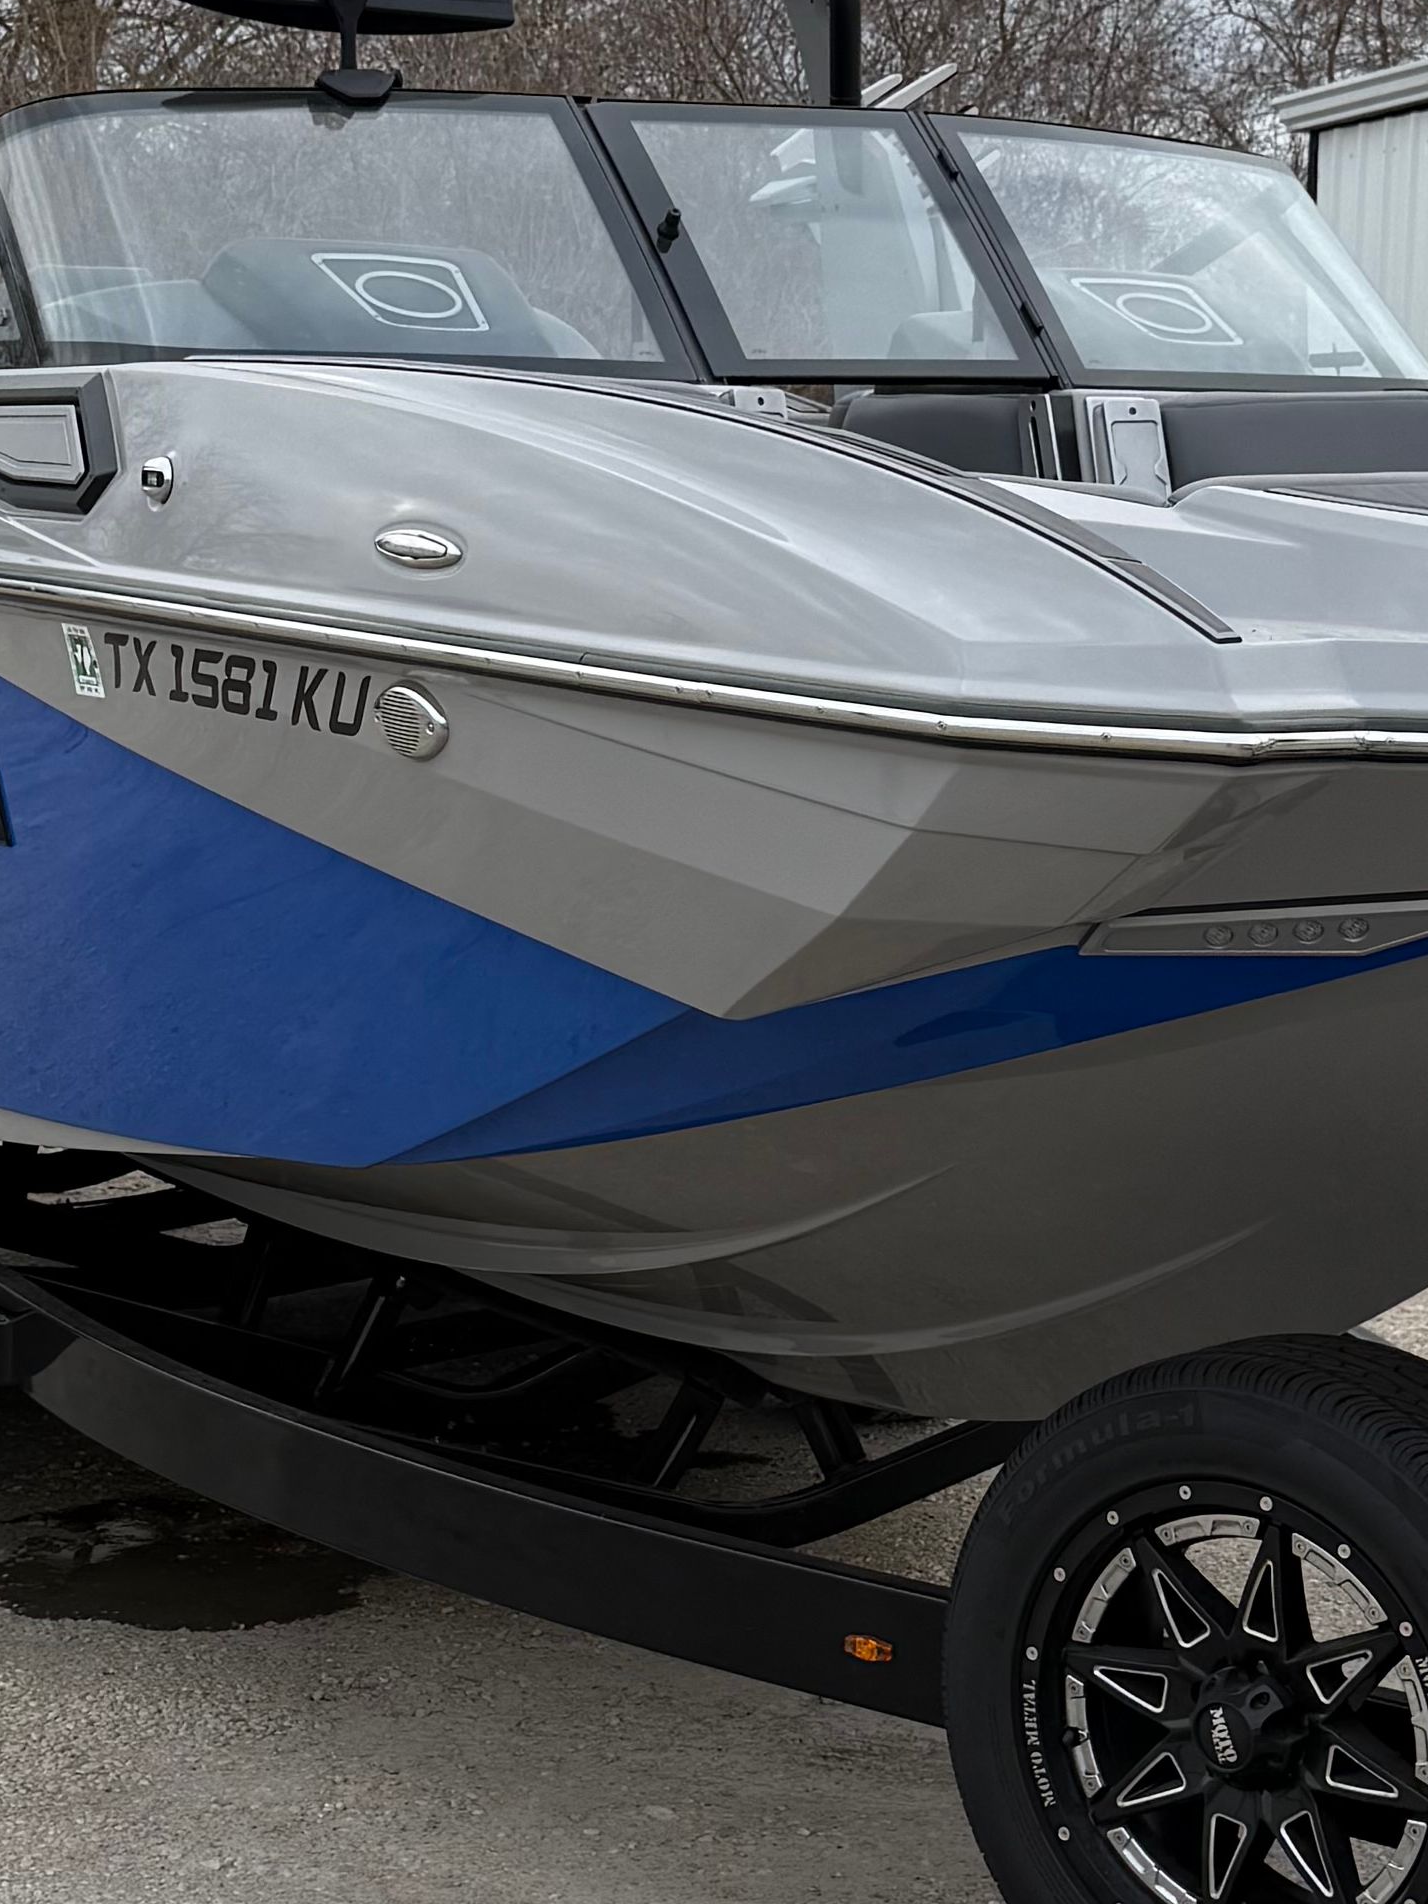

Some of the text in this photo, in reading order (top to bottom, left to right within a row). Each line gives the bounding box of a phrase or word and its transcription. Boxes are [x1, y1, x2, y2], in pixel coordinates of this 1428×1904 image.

[104, 632, 371, 736] TX 1581 KU
[1022, 1679, 1057, 1808] MOTO METAL
[1210, 1707, 1238, 1763] MOTO
